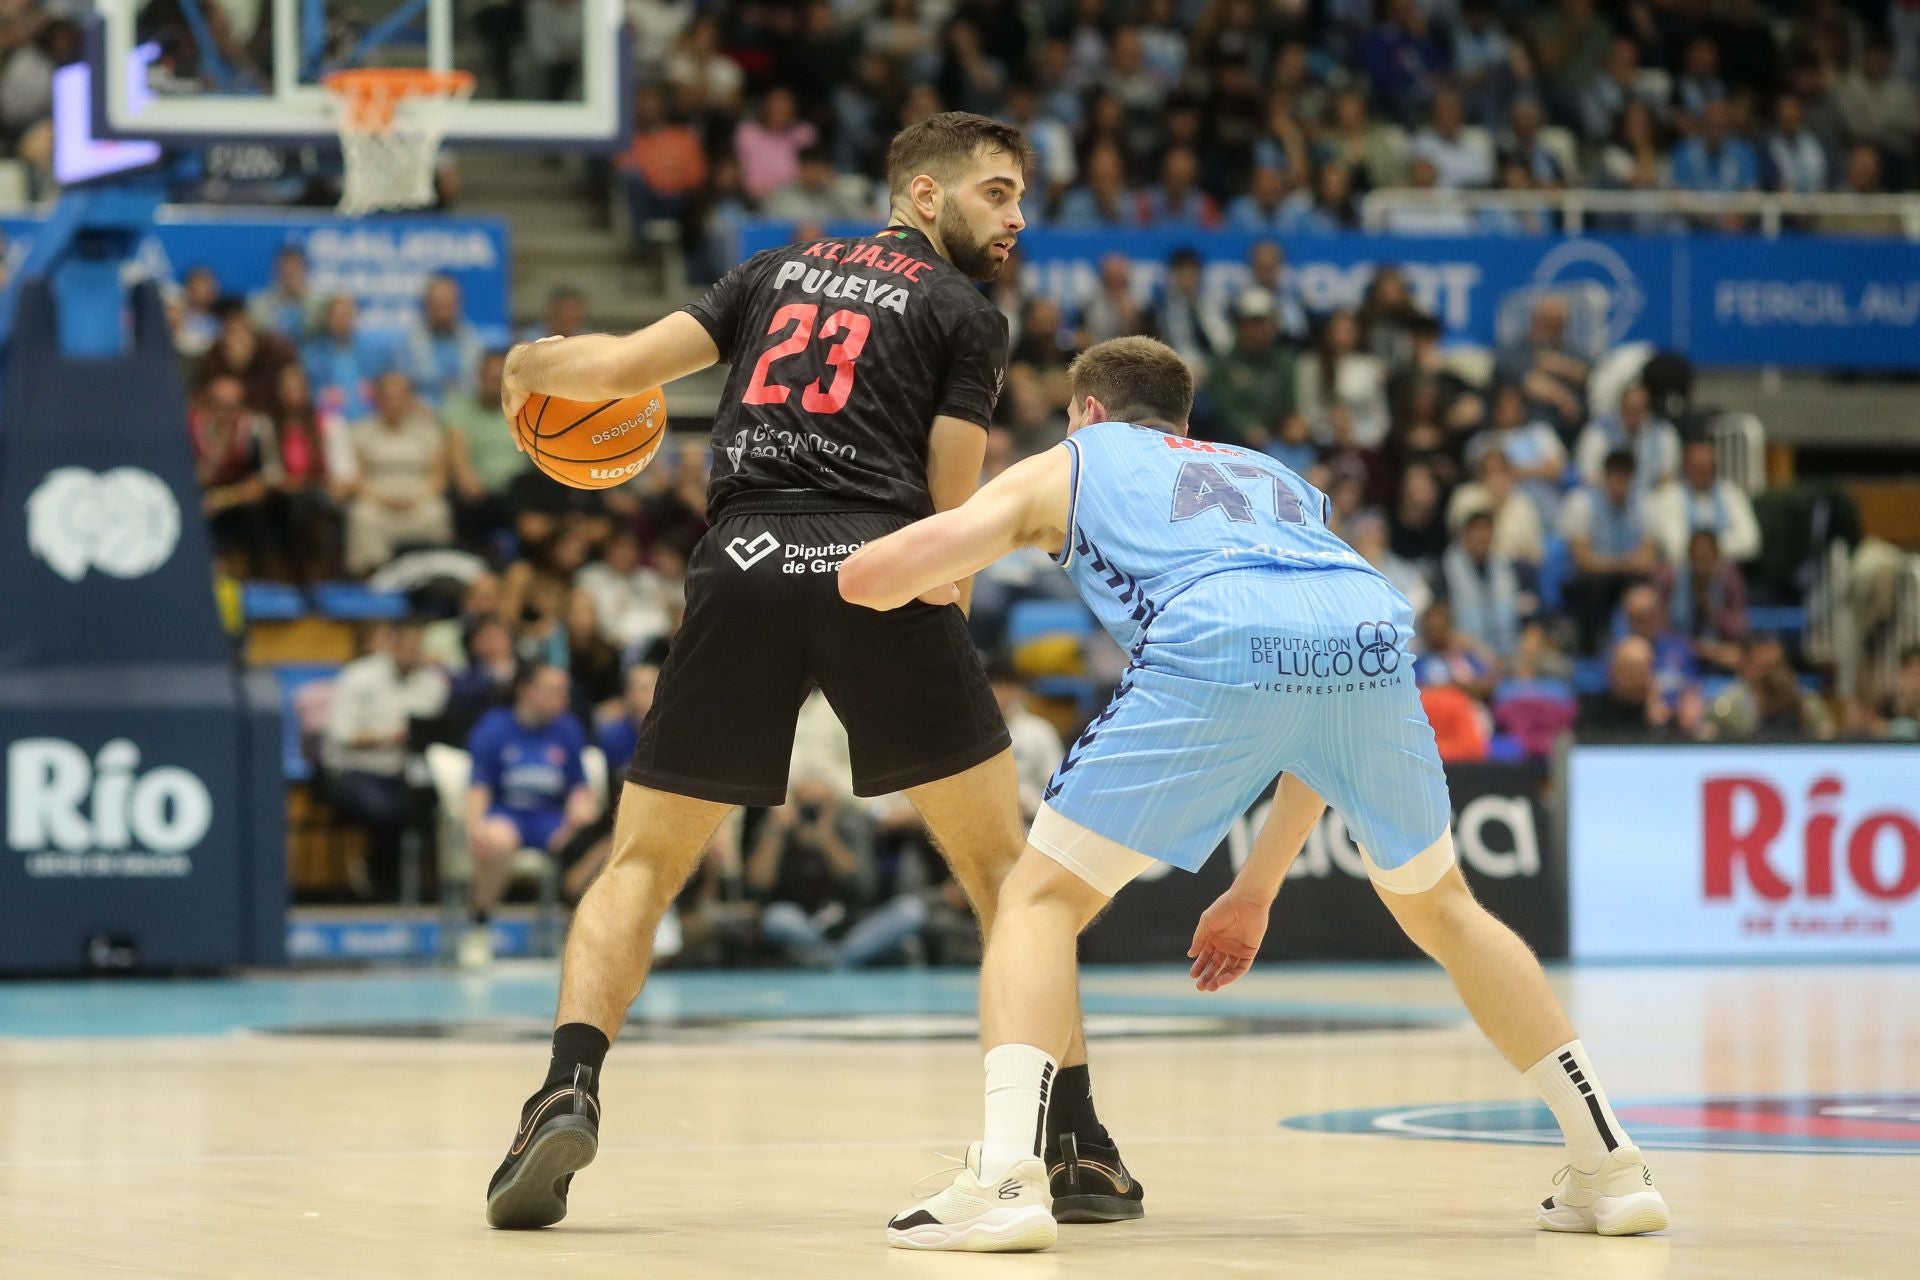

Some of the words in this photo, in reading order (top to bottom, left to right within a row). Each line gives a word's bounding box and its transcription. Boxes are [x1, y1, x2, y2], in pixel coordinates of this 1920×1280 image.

[773, 260, 910, 316] PULEVA
[741, 303, 871, 414] 23
[1170, 461, 1306, 526] 47
[782, 561, 805, 574] de
[1250, 636, 1350, 653] DEPUTACIÓN
[1252, 651, 1274, 664] DE
[1277, 650, 1353, 678] LUGO
[1253, 676, 1402, 695] VICEPRESIDENCIA
[1701, 774, 1920, 903] Río
